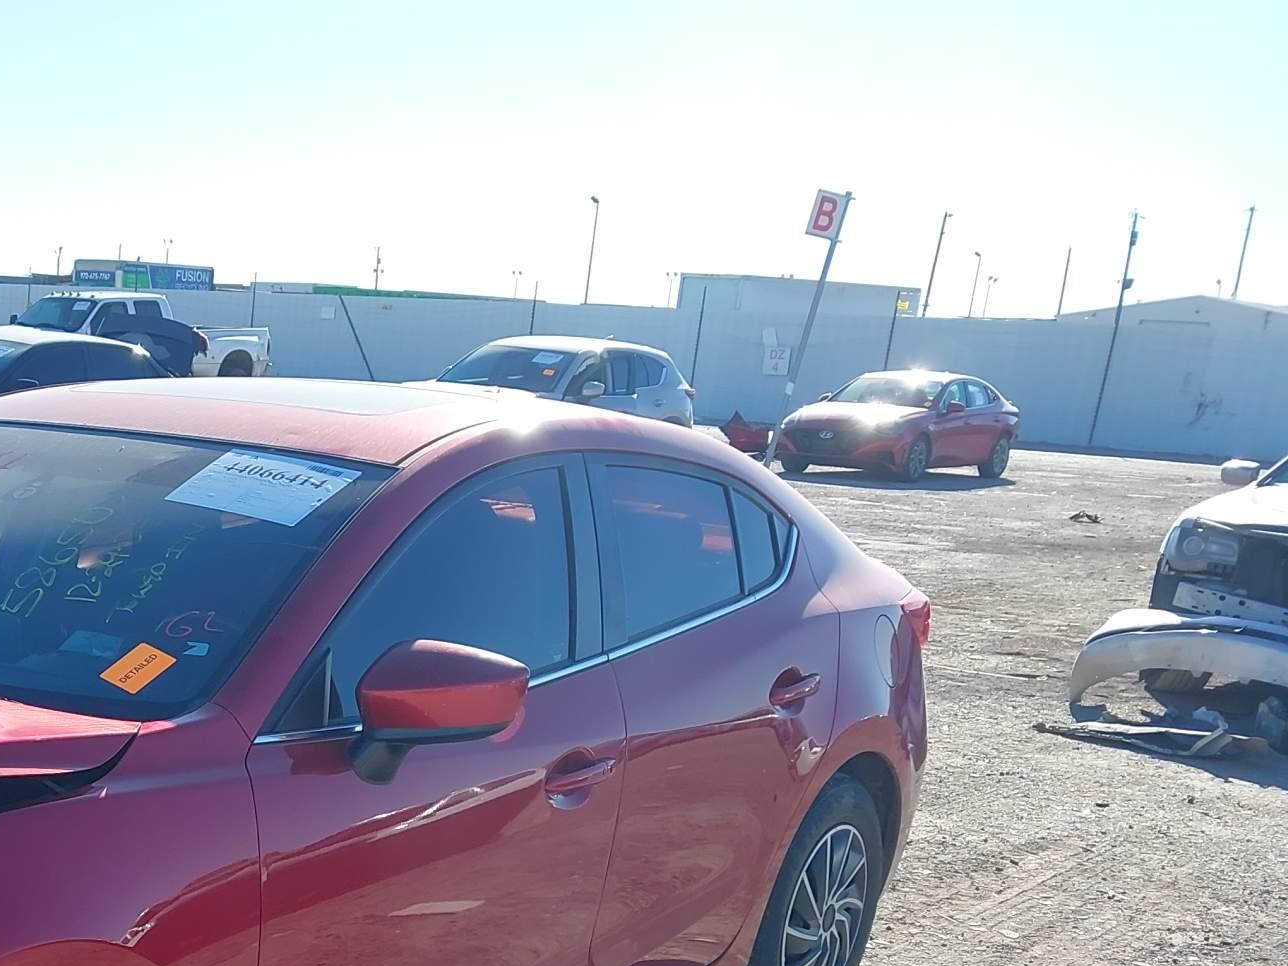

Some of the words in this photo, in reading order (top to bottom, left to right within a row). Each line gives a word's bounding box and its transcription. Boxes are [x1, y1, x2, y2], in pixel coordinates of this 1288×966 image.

[812, 196, 838, 232] B
[175, 269, 210, 283] FUSION
[223, 461, 330, 491] 44066414
[118, 653, 159, 685] DETAILED
